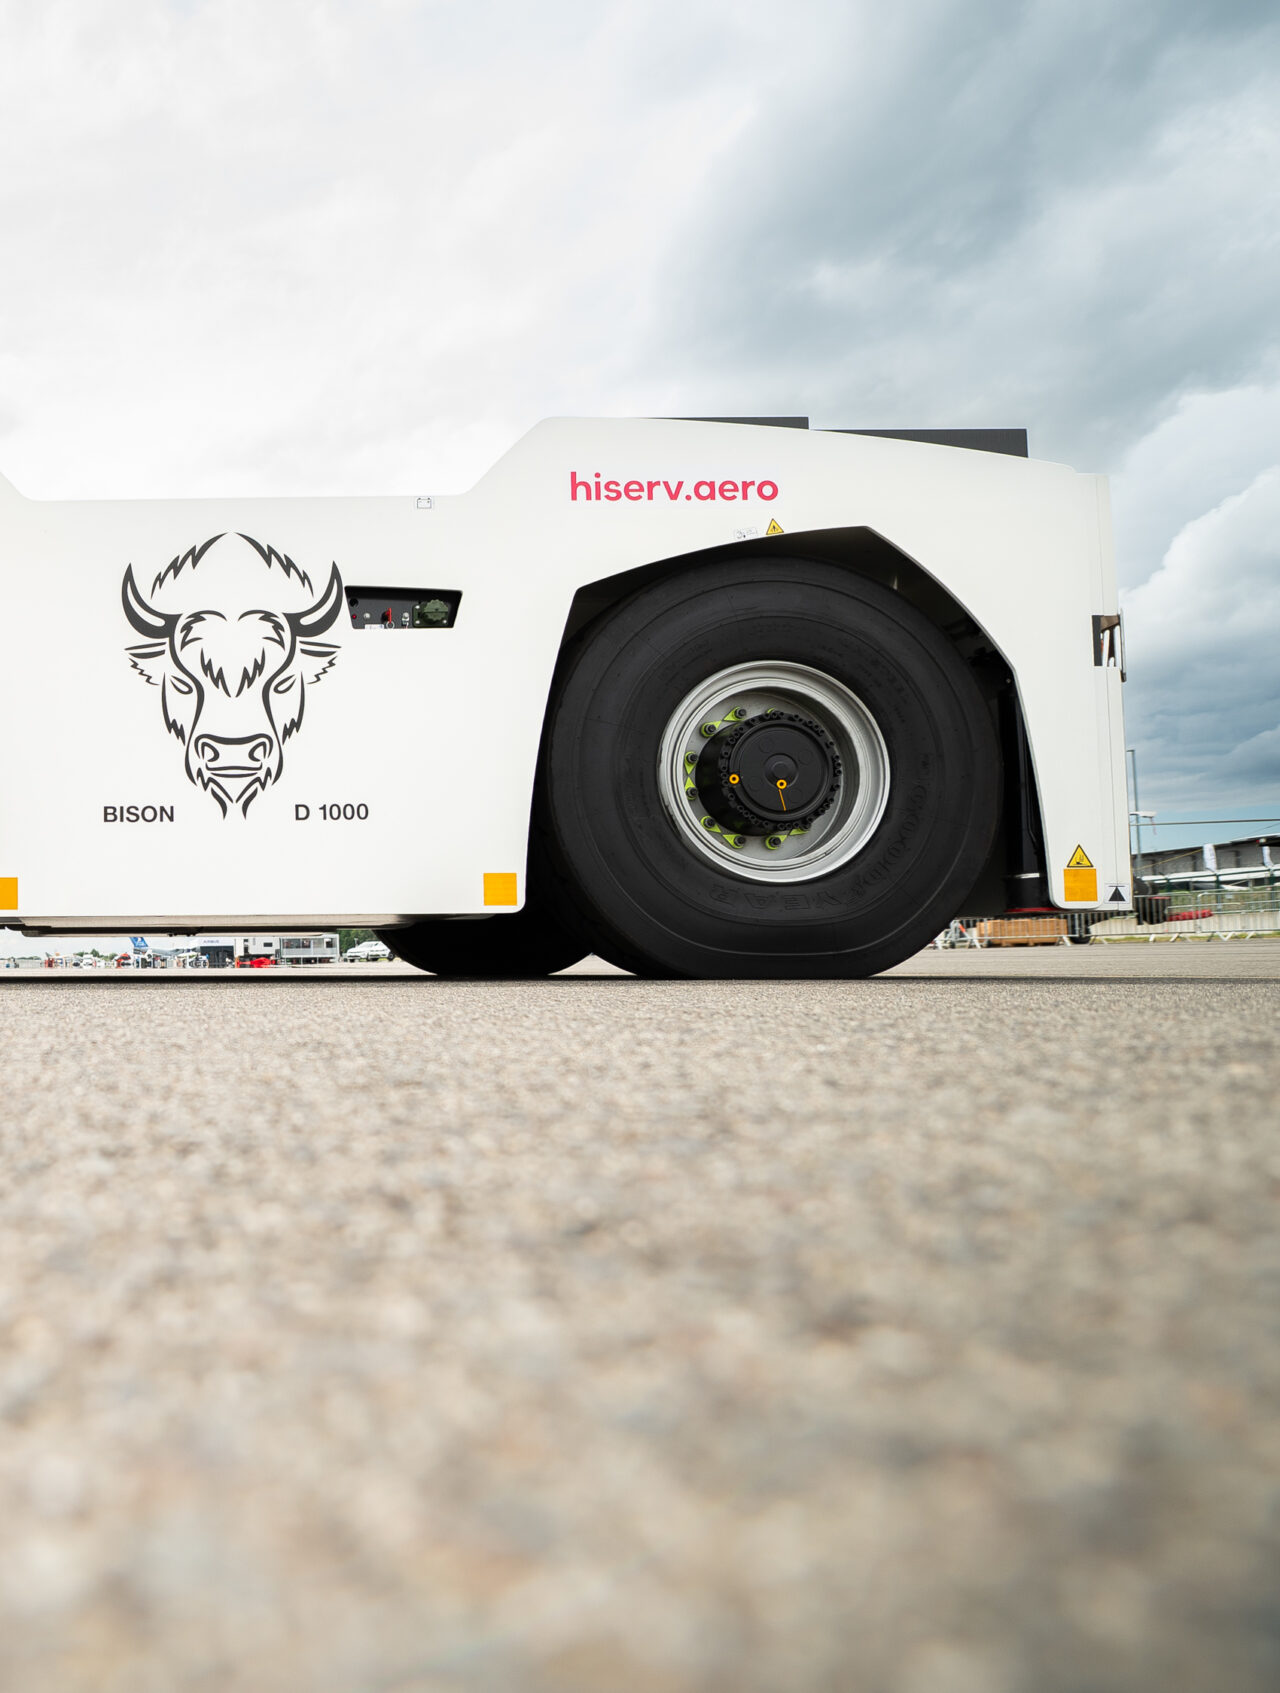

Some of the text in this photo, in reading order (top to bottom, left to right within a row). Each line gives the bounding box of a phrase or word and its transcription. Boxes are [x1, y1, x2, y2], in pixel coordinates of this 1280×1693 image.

[570, 471, 779, 502] hiserv.aero
[103, 805, 175, 823] BISON
[294, 803, 369, 821] D 1000
